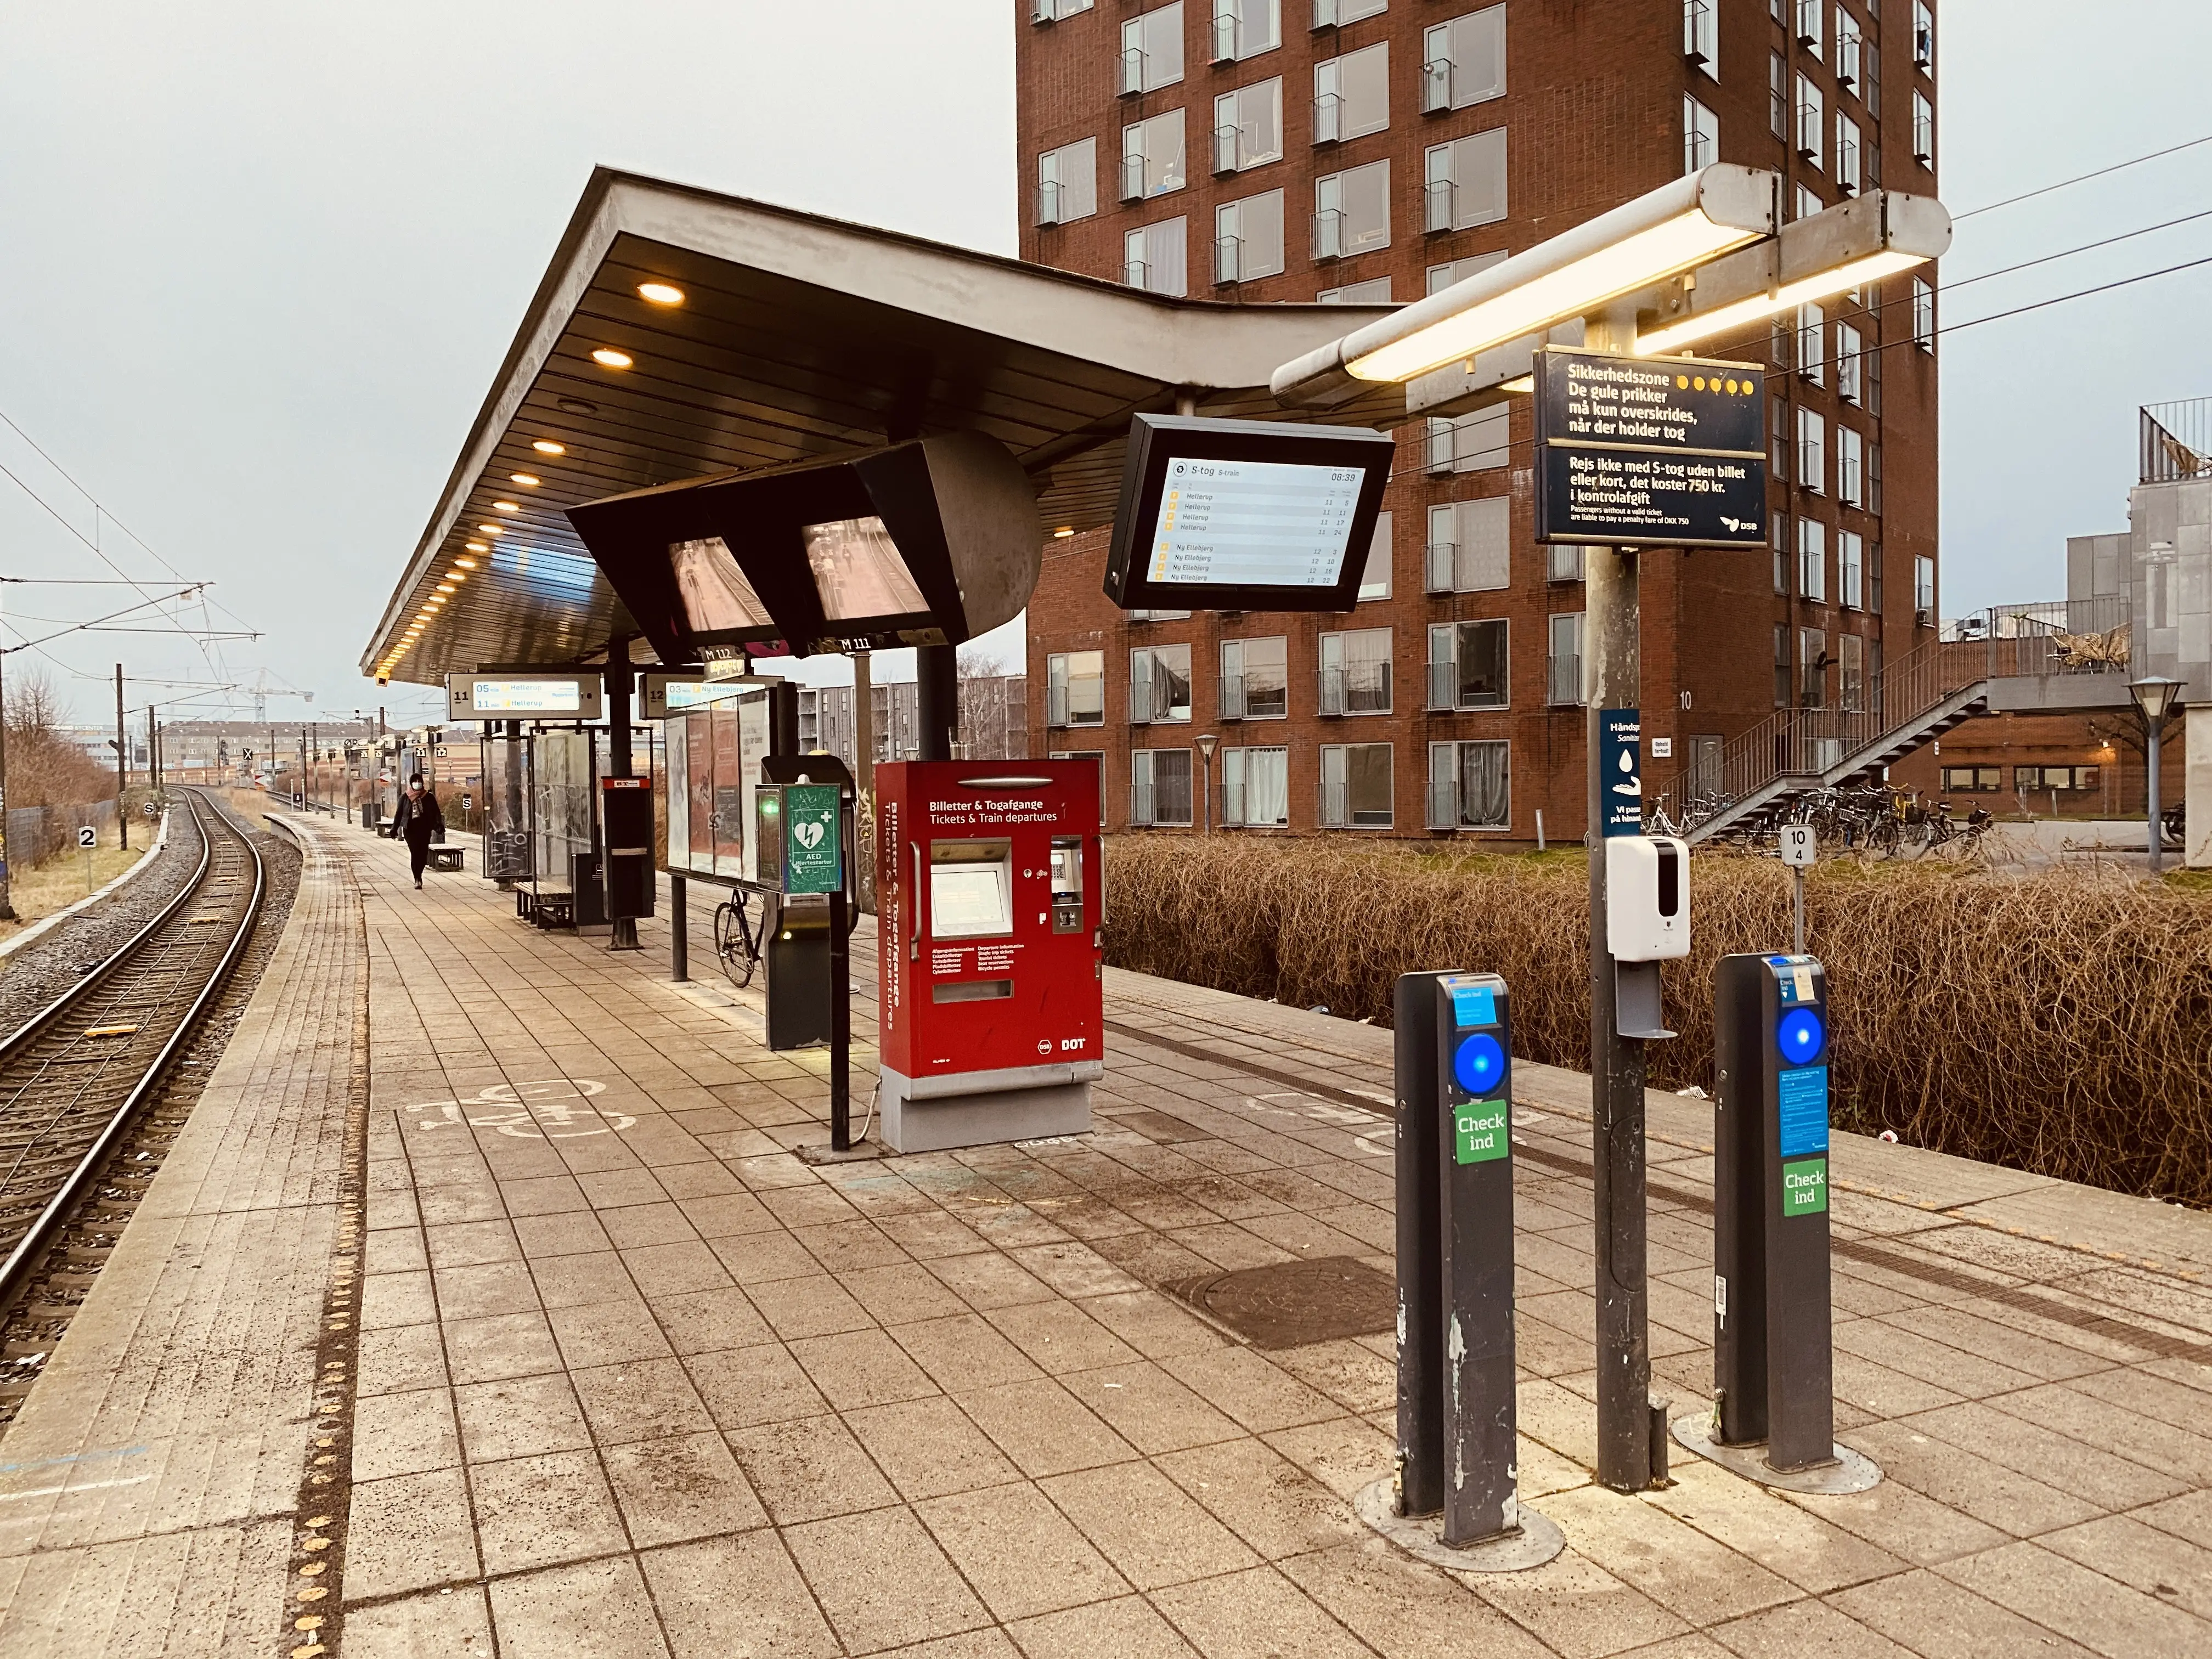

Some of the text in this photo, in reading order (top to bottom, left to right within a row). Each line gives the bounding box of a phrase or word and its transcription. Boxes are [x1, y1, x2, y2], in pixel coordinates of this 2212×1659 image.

[1568, 364, 1669, 386] Sikkerhedszone
[1569, 382, 1667, 404] De gule prikker
[1569, 400, 1697, 425] må kun overskrides,
[1569, 418, 1685, 441] når der holder tog
[1192, 466, 1214, 476] S-tog
[1570, 457, 1745, 479] Rejs ikke med S-tog uden billet
[1331, 473, 1355, 482] 08:39
[1570, 474, 1725, 493] eller kort, det koster 750 kr.
[1570, 491, 1650, 506] i kontrolafgift
[1571, 505, 1602, 514] Passengers
[1623, 516, 1644, 524] penalty
[1657, 516, 1663, 524] of
[841, 637, 871, 650] M 111
[706, 648, 732, 660] M 112
[454, 691, 469, 700] 11
[702, 686, 711, 695] Ny
[1680, 691, 1692, 710] 10
[145, 804, 154, 813] S
[930, 801, 972, 811] Billetter
[974, 800, 983, 810] &
[930, 812, 1057, 824] Tickets & Train departures
[1610, 815, 1621, 824] på
[81, 830, 94, 845] 2
[1791, 831, 1805, 845] 10
[1795, 850, 1803, 860] 4
[886, 870, 892, 881] &
[893, 881, 899, 895] &
[1062, 1039, 1084, 1050] DOT
[1458, 1113, 1504, 1133] Check
[1470, 1133, 1494, 1150] ind
[1786, 1171, 1824, 1188] Check
[1795, 1188, 1815, 1205] ind
